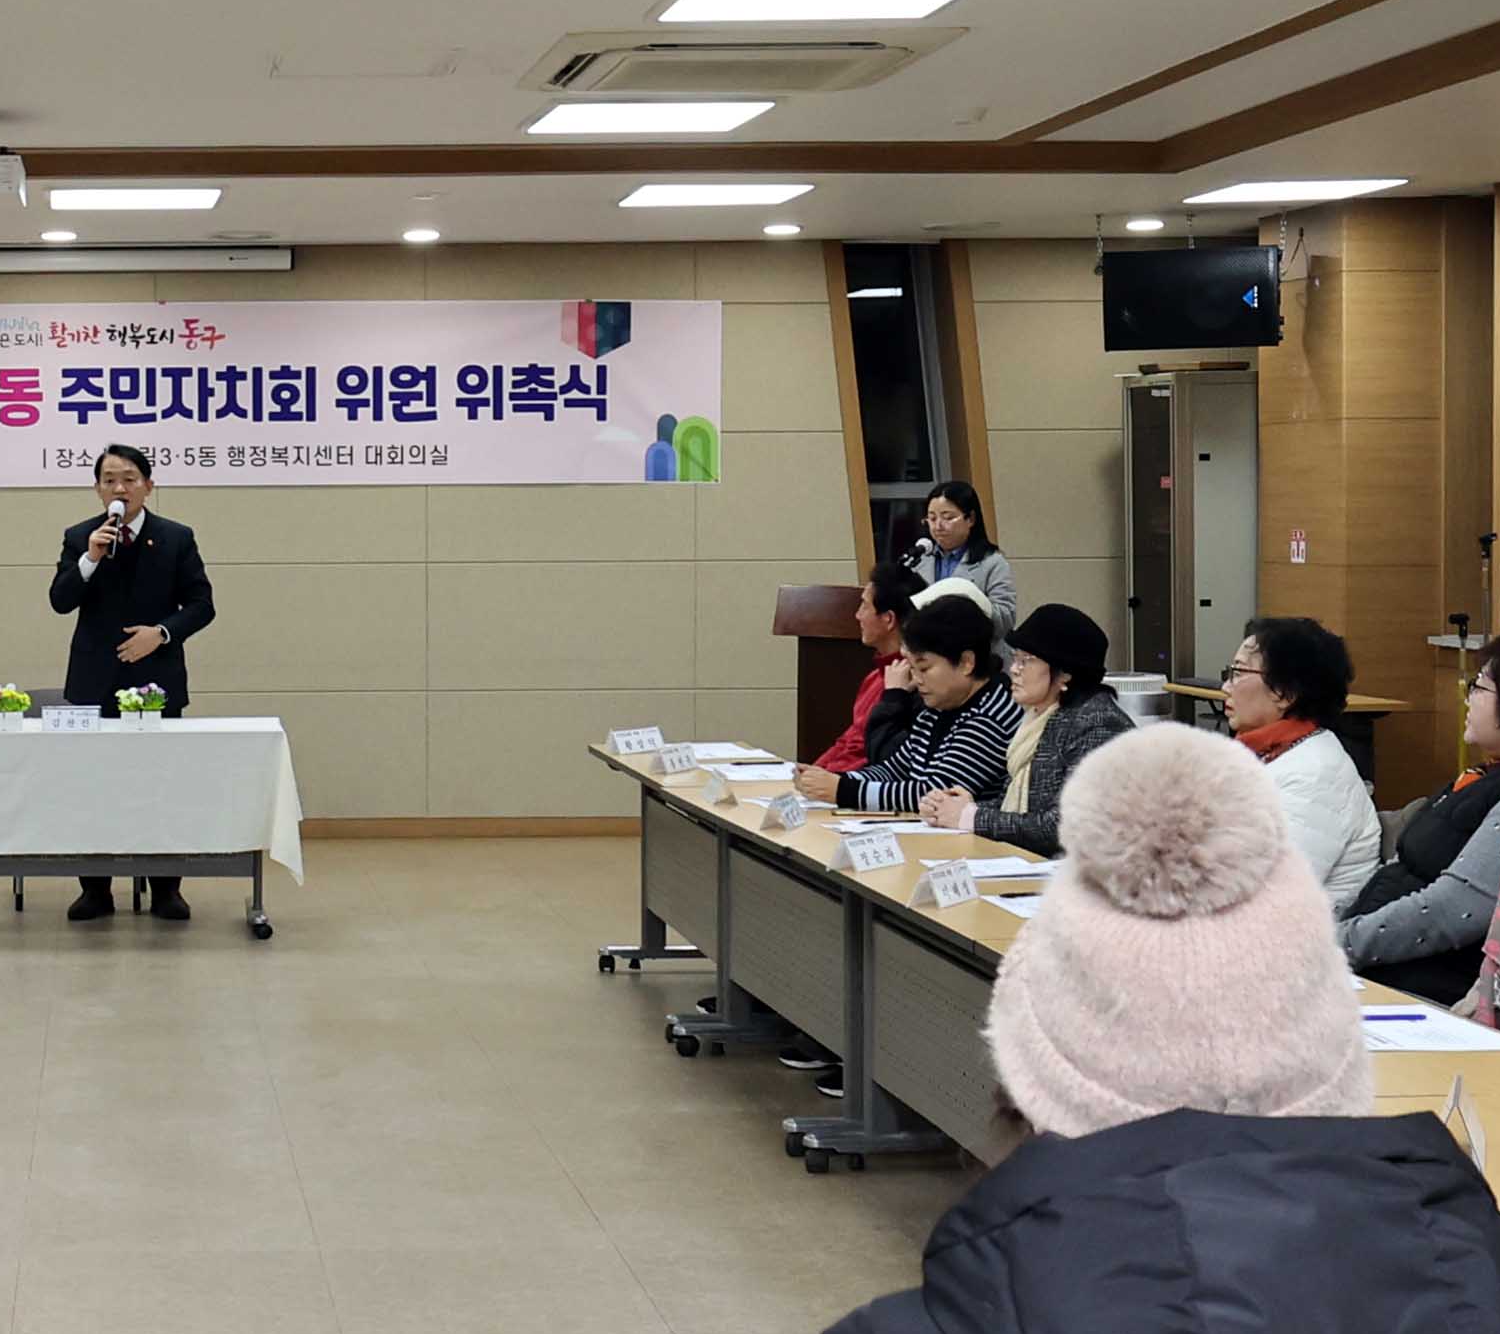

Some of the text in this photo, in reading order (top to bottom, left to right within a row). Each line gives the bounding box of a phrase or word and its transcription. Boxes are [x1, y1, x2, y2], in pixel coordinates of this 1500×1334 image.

[14, 332, 43, 348] 도시!
[48, 320, 101, 349] 활기찬
[105, 324, 175, 350] 행복도시
[178, 318, 226, 351] 동구
[58, 365, 317, 425] 주민자치회
[335, 364, 438, 423] 위원
[455, 363, 608, 422] 위촉식
[55, 447, 93, 468] 장소
[227, 445, 354, 467] 행정복지센터
[364, 444, 449, 465] 대회의실
